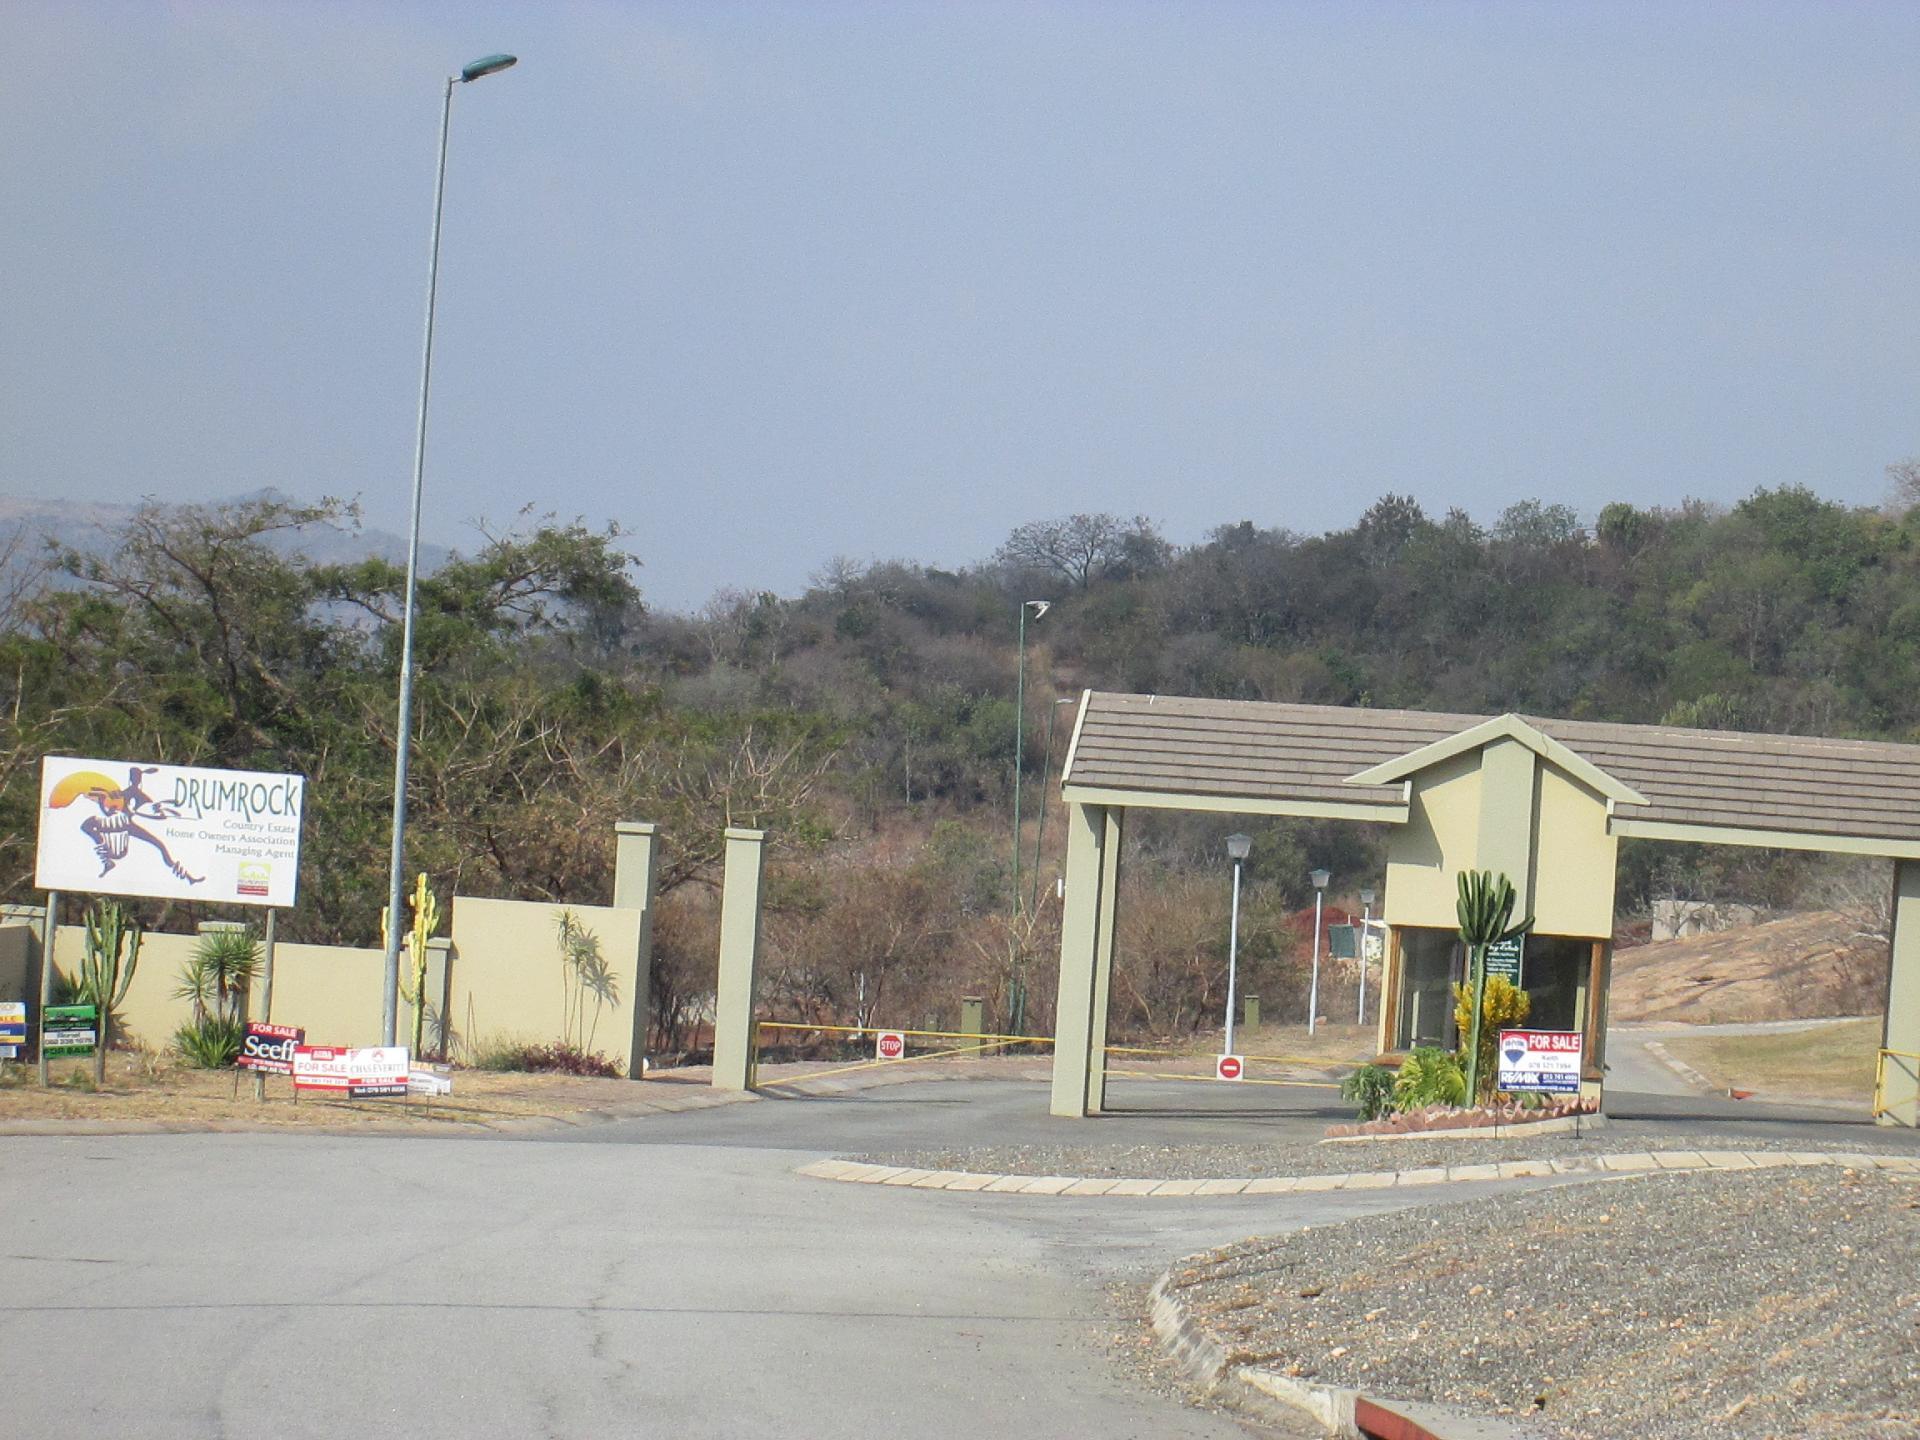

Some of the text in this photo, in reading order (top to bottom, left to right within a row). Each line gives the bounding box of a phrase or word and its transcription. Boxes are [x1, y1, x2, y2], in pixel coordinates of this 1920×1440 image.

[174, 777, 298, 822] DRUMROCK
[223, 820, 296, 833] Country Estate
[166, 828, 296, 846] Home Owners Association
[215, 844, 295, 859] Managing Agent
[253, 1024, 297, 1037] FOR SALE
[244, 1036, 299, 1062] Seeff
[881, 1040, 900, 1051] STOP
[1529, 1034, 1579, 1050] FOR SALE
[298, 1062, 319, 1072] FOR
[321, 1063, 347, 1073] SALE
